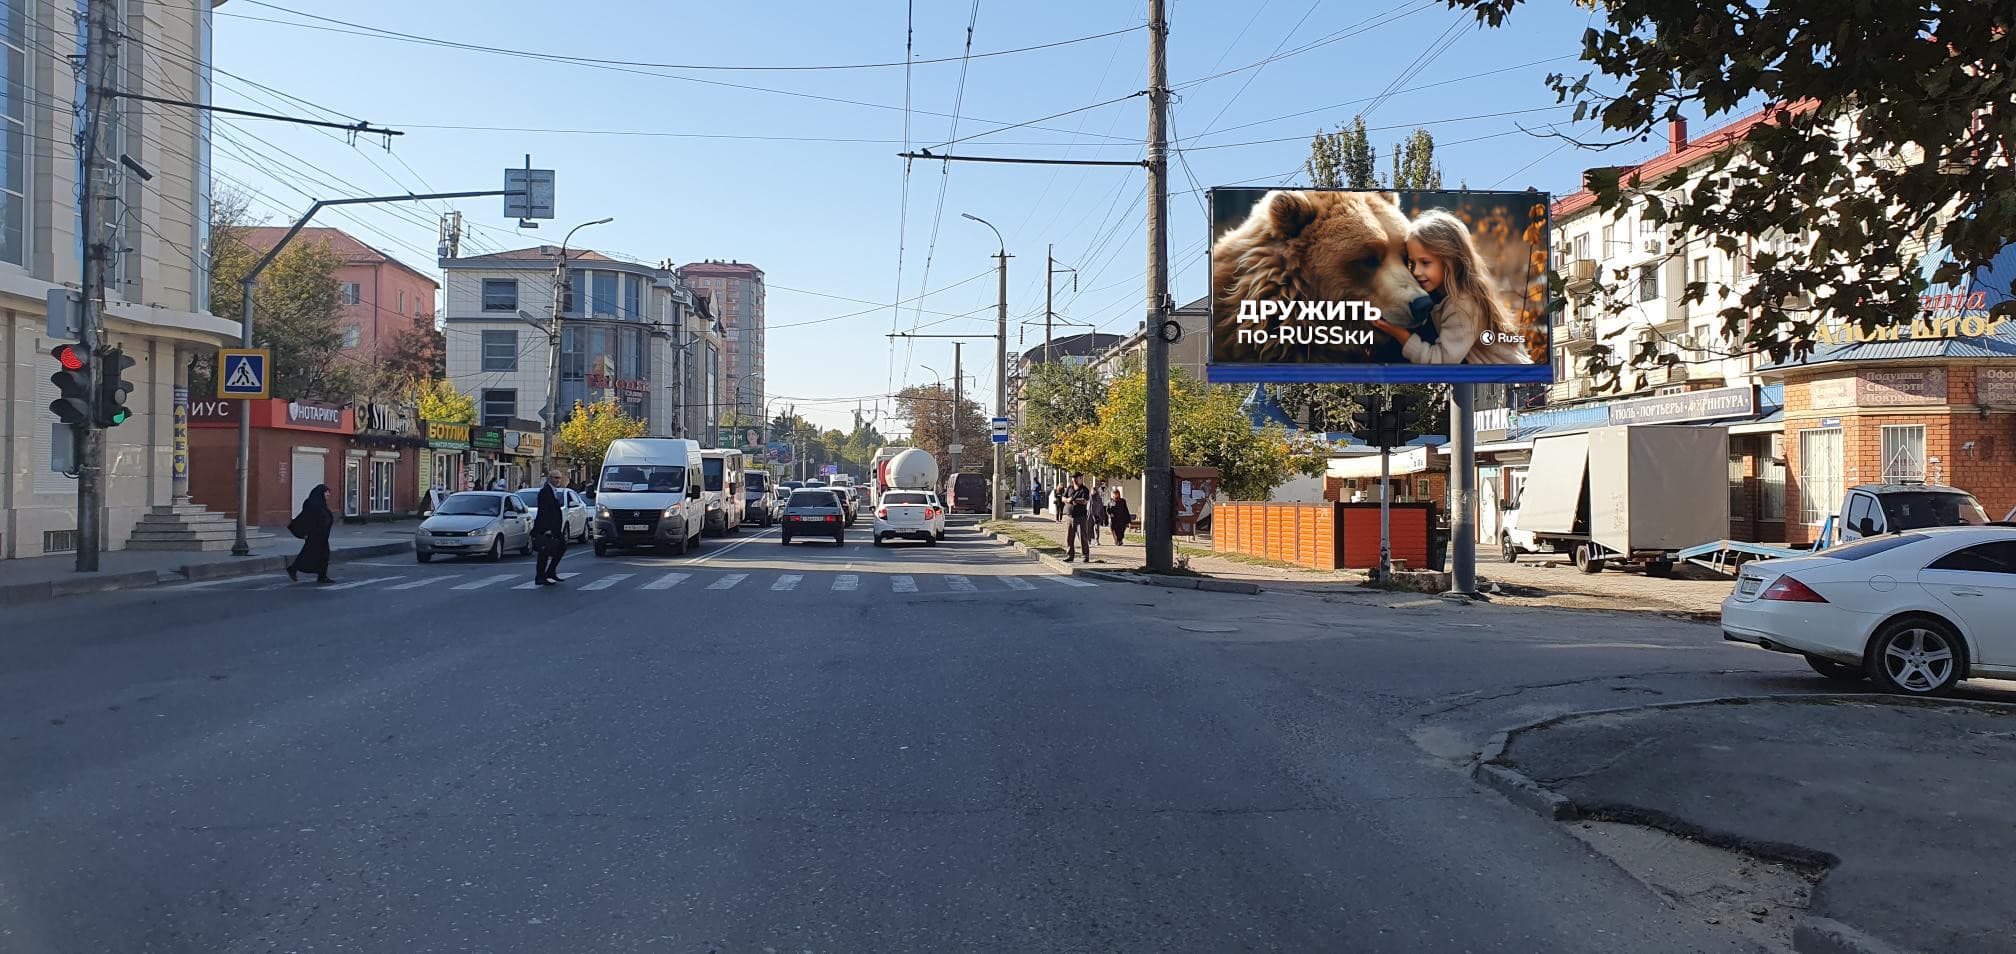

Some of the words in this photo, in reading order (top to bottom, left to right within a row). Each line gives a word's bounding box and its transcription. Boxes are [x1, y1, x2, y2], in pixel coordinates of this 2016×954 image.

[1236, 300, 1382, 324] ДРУЖИТЬ
[1238, 325, 1374, 345] по-RUSSки
[1497, 332, 1526, 343] Russ
[1866, 372, 1924, 382] Подушки
[1866, 382, 1925, 392] Скатерти
[298, 405, 339, 423] НОТАРИУС
[1640, 400, 1684, 416] ПОРТЬЕРЫ
[1687, 394, 1744, 412] ФУРНИТУРА
[429, 422, 470, 442] БОТЛИХ
